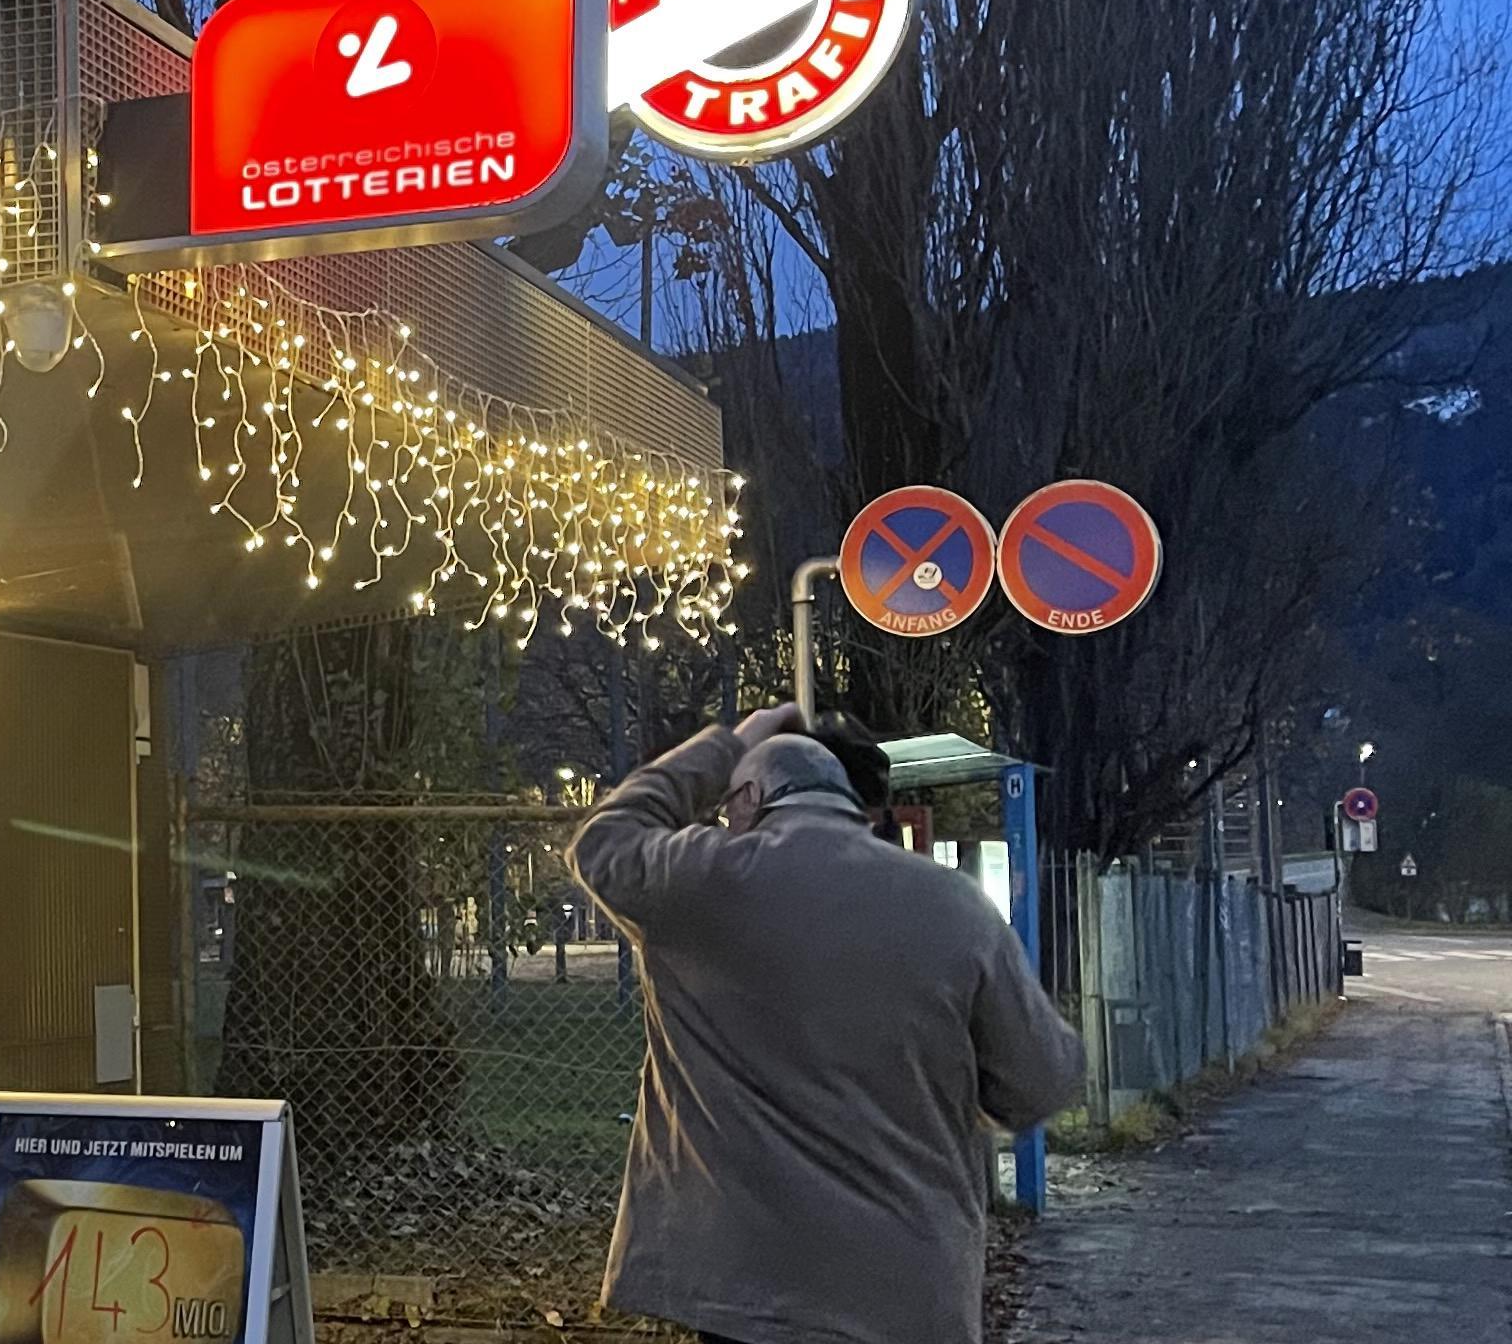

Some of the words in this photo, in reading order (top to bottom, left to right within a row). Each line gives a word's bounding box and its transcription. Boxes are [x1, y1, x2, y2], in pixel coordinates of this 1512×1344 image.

[241, 131, 516, 180] österreichische
[242, 154, 515, 211] LOTTERIEN
[879, 607, 957, 632] ANFANG
[1047, 608, 1105, 628] ENDE
[15, 1137, 47, 1154] HIER
[50, 1139, 81, 1155] UND
[83, 1140, 128, 1156] JETZT
[130, 1141, 216, 1160] MITSPIELEN
[216, 1145, 243, 1161] UM
[29, 1224, 171, 1340] 143
[173, 1296, 231, 1339] MIO.
